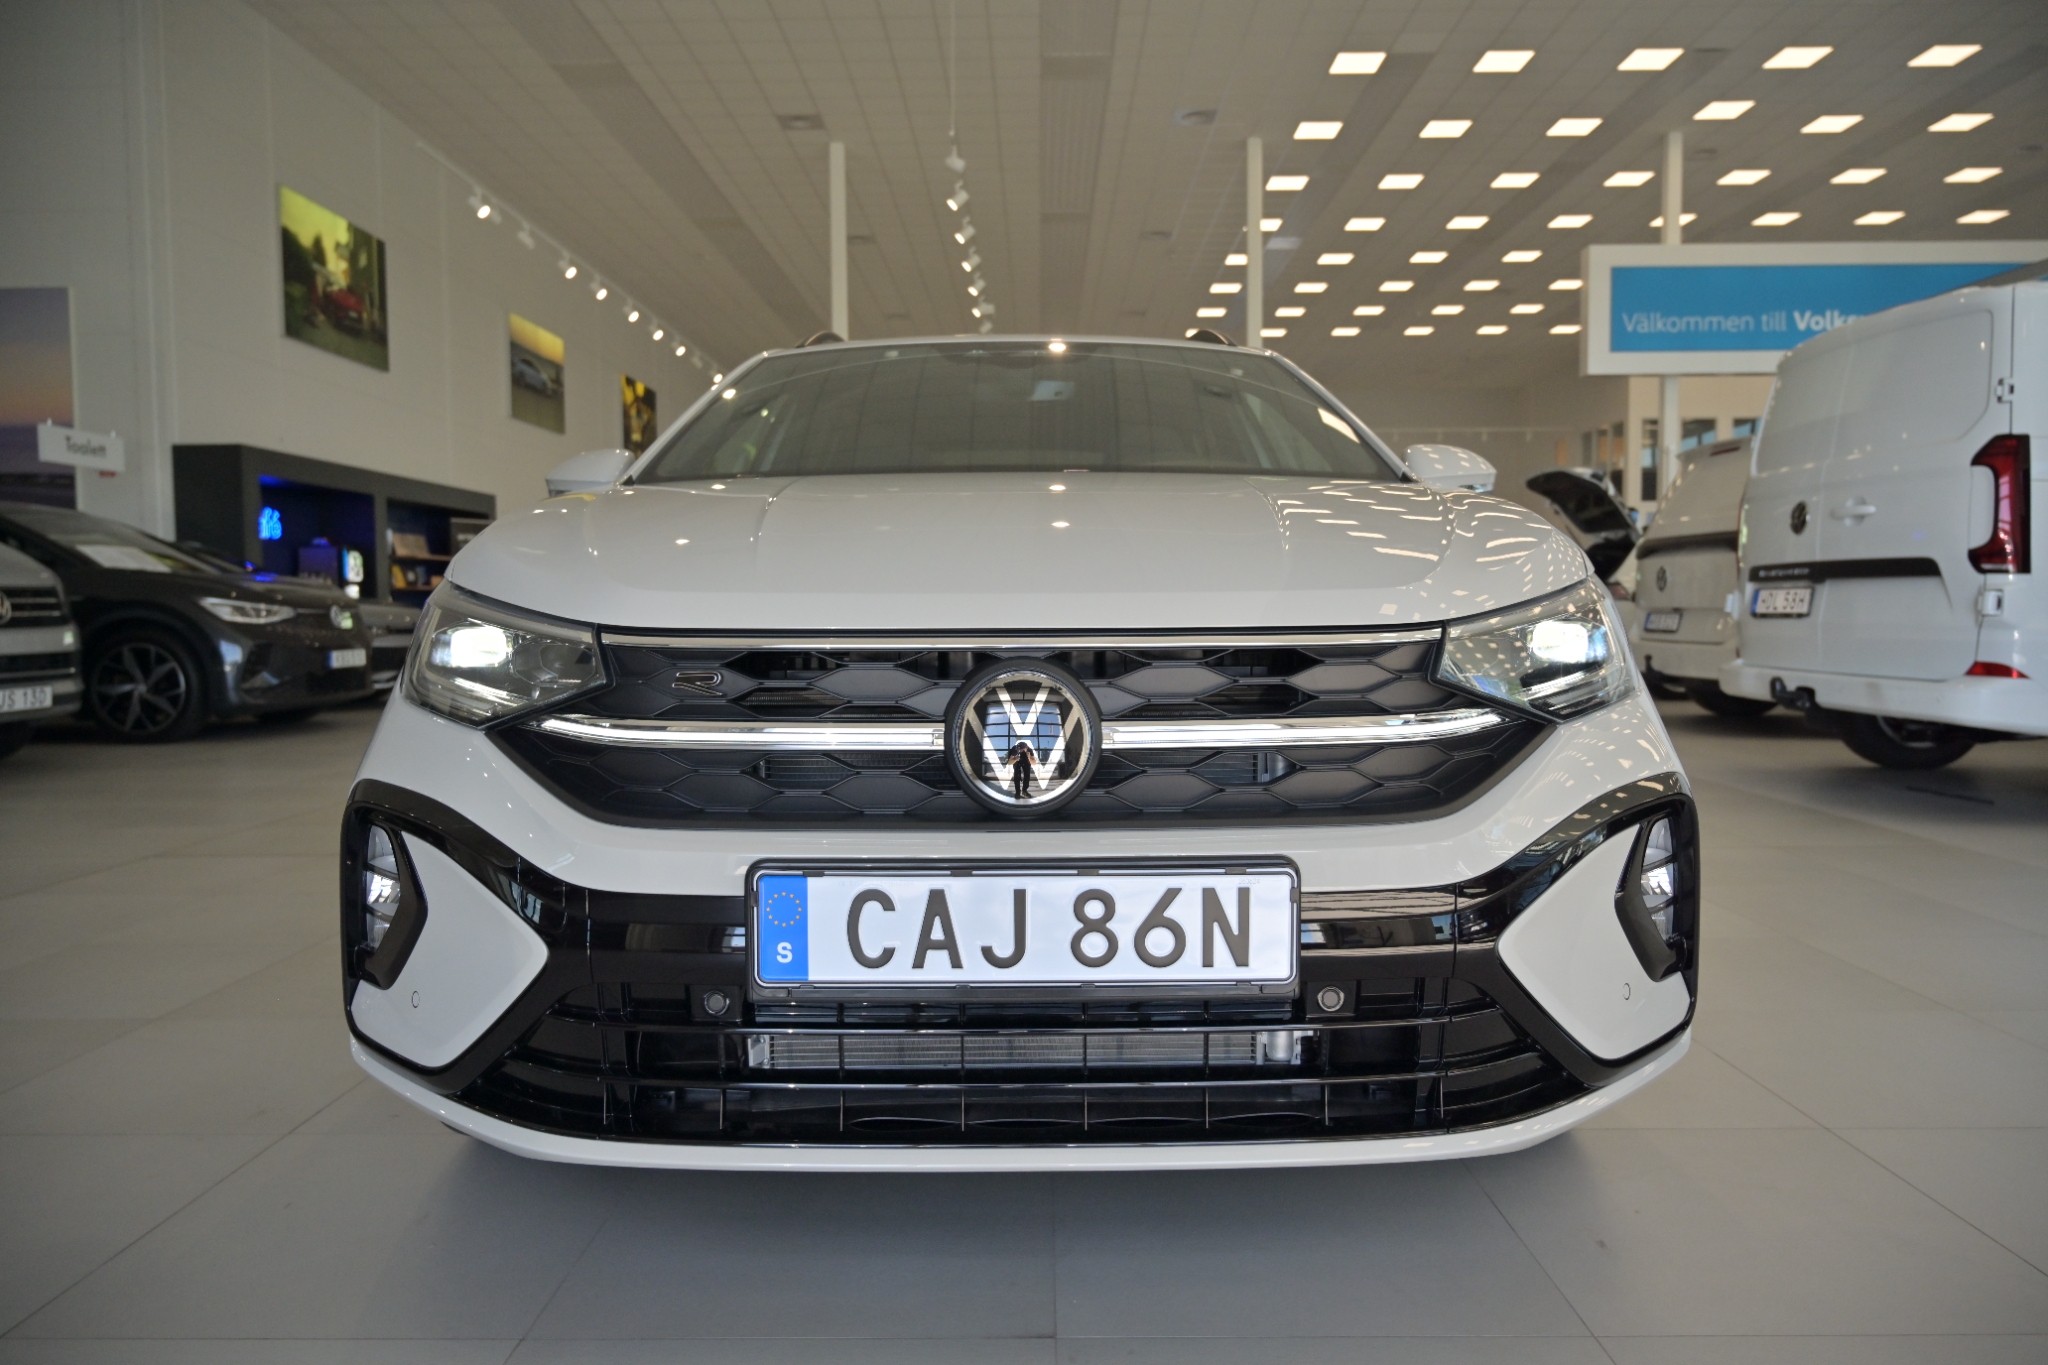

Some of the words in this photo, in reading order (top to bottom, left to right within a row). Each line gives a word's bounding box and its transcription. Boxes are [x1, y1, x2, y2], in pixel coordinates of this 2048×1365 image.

[1622, 311, 1754, 333] Välkommen
[1761, 311, 1787, 332] till
[847, 888, 1026, 969] CAJ
[1071, 888, 1250, 968] 86N
[776, 941, 793, 963] S
